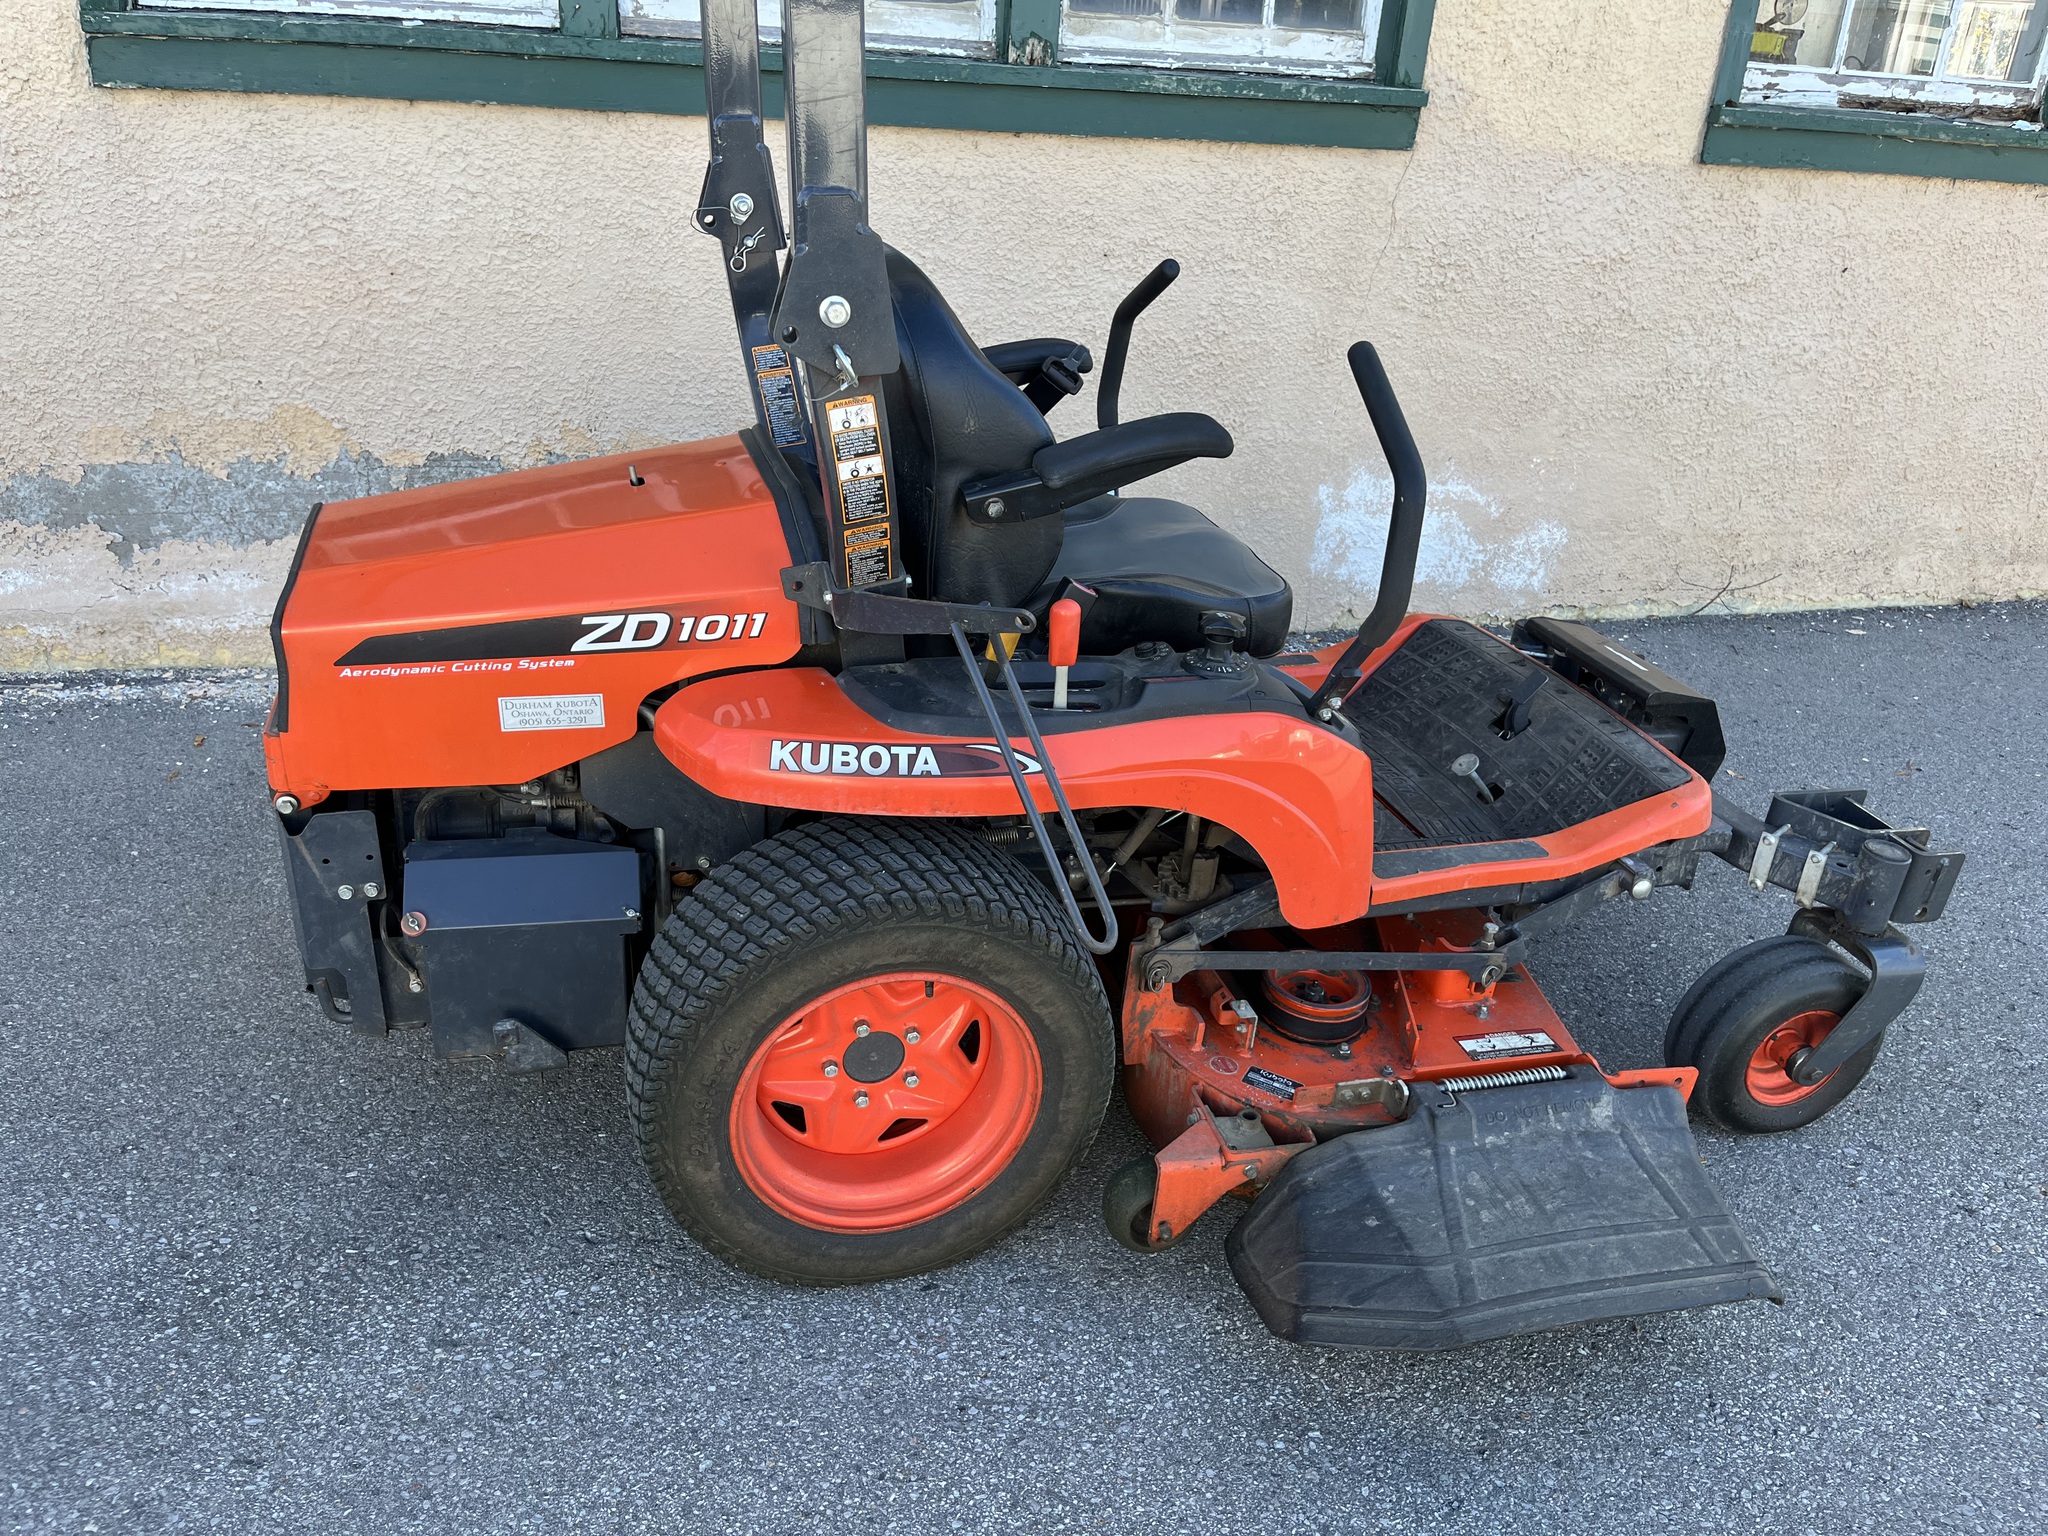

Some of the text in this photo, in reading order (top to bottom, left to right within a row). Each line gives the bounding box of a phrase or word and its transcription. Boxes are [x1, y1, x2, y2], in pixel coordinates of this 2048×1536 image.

[837, 397, 867, 406] WARNING
[857, 542, 884, 550] WARNING
[570, 612, 768, 652] ZD 1011
[339, 658, 575, 678] Aerodynamic Cutting System
[504, 700, 552, 711] DURHAM
[511, 708, 594, 718] OSHAWA, ONTARIO
[519, 716, 587, 726] (905) 655-3291
[769, 740, 942, 776] KUBOTA
[1260, 1069, 1292, 1086] Kubota
[1484, 1110, 1508, 1125] DO
